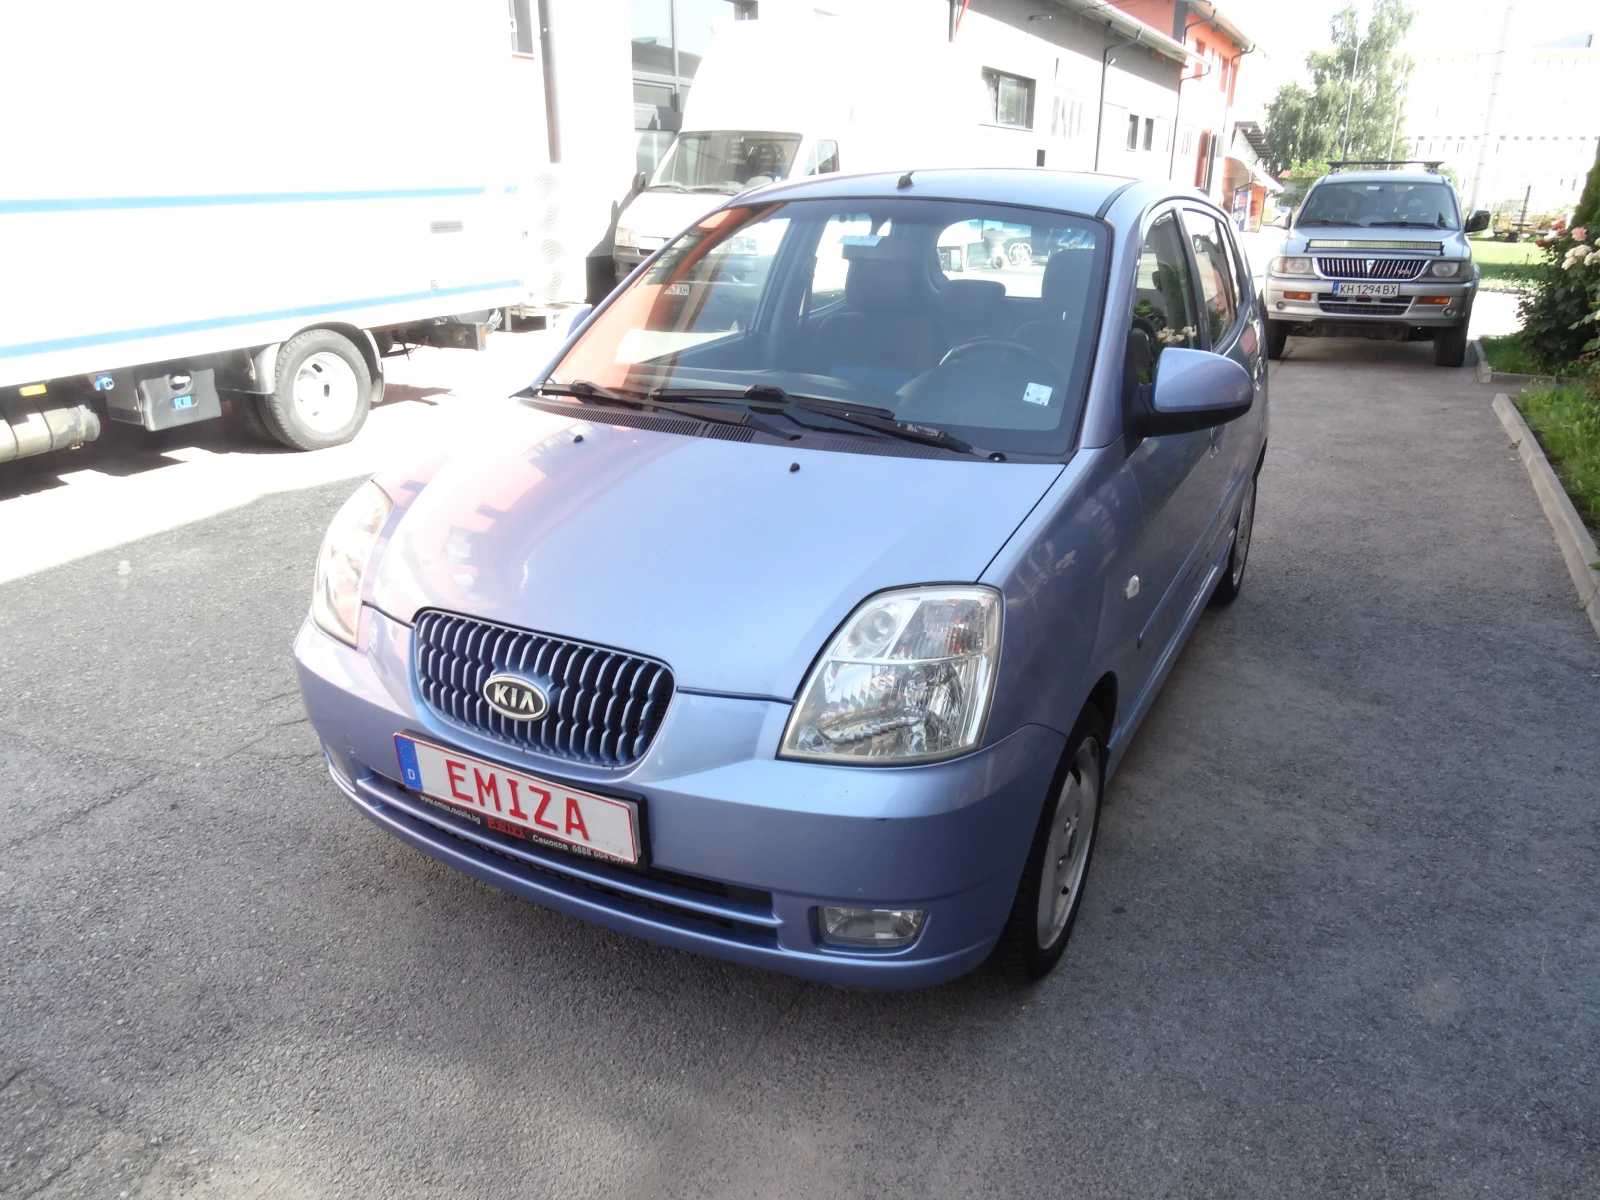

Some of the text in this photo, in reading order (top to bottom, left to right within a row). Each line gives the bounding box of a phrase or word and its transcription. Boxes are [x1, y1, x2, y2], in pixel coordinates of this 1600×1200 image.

[1340, 284, 1397, 295] KH 1294 BX
[494, 683, 536, 713] KIA
[407, 758, 590, 842] D EMIZA
[532, 834, 568, 851] Самоков
[572, 844, 592, 856] 0888
